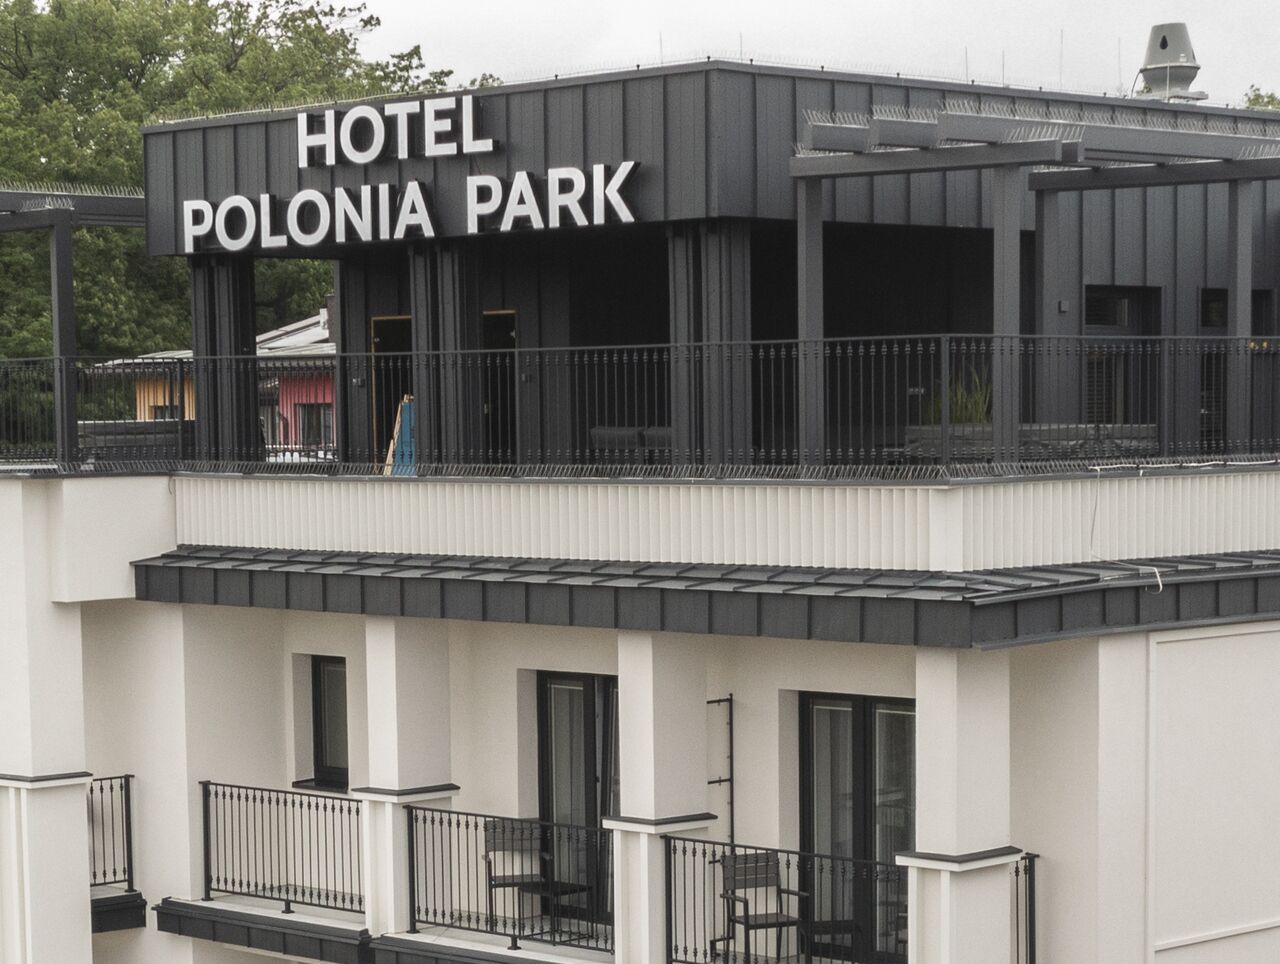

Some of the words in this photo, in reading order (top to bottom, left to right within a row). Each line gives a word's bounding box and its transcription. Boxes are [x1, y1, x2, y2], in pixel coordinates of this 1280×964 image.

[297, 95, 494, 169] HOTEL
[183, 181, 435, 254] POLONIA
[467, 160, 637, 234] PARK
